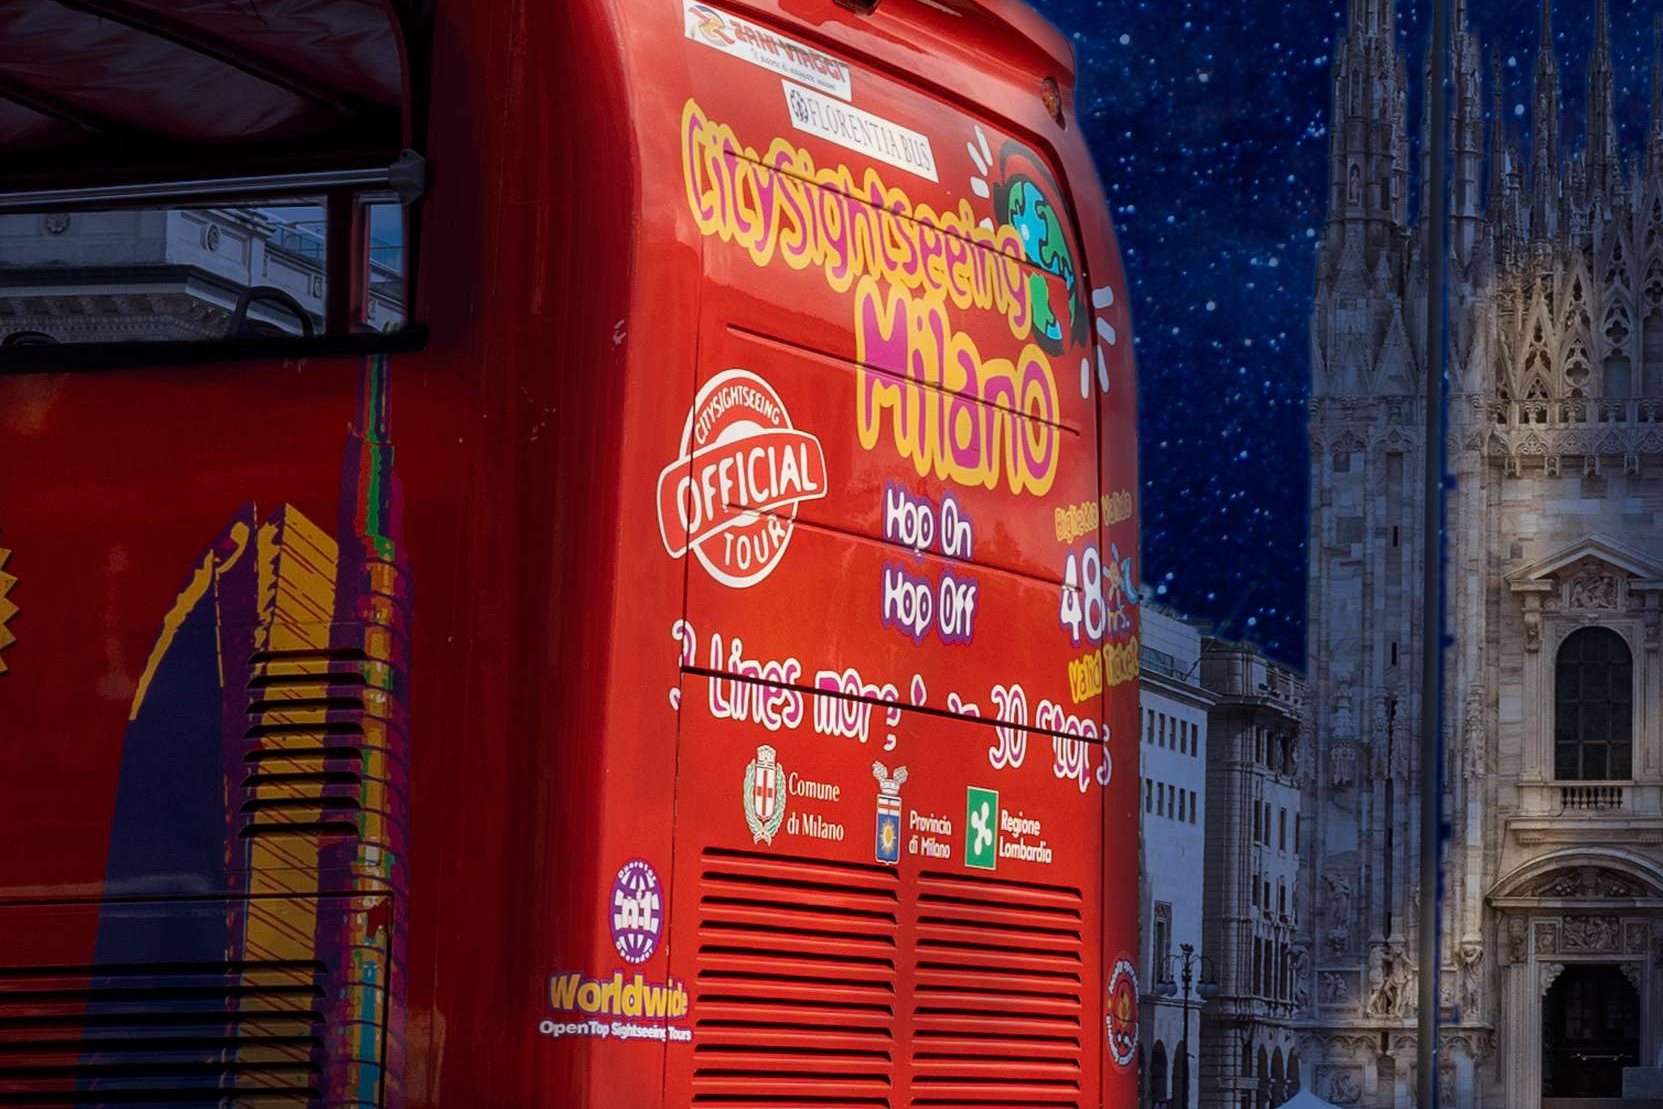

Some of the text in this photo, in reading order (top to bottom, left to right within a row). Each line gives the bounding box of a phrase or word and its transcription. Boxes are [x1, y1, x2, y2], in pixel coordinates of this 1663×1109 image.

[807, 97, 931, 172] FLORENTIA BUS
[694, 384, 781, 445] CITYSIGHTSEEING
[854, 274, 1061, 497] Milano
[676, 442, 818, 535] OFFICIAL
[723, 514, 786, 571] TOUR
[885, 487, 973, 558] Hop On
[883, 567, 978, 638] Hop Off
[1060, 547, 1106, 642] 48
[708, 632, 804, 732] Lines
[988, 683, 1028, 770] 30
[788, 771, 841, 803] Comune
[787, 812, 845, 842] di Milano
[908, 834, 951, 860] di Milano
[909, 809, 952, 836] Provincia
[999, 835, 1052, 864] Lombardia
[1001, 809, 1041, 839] Regione
[550, 971, 689, 1018] Worldwide
